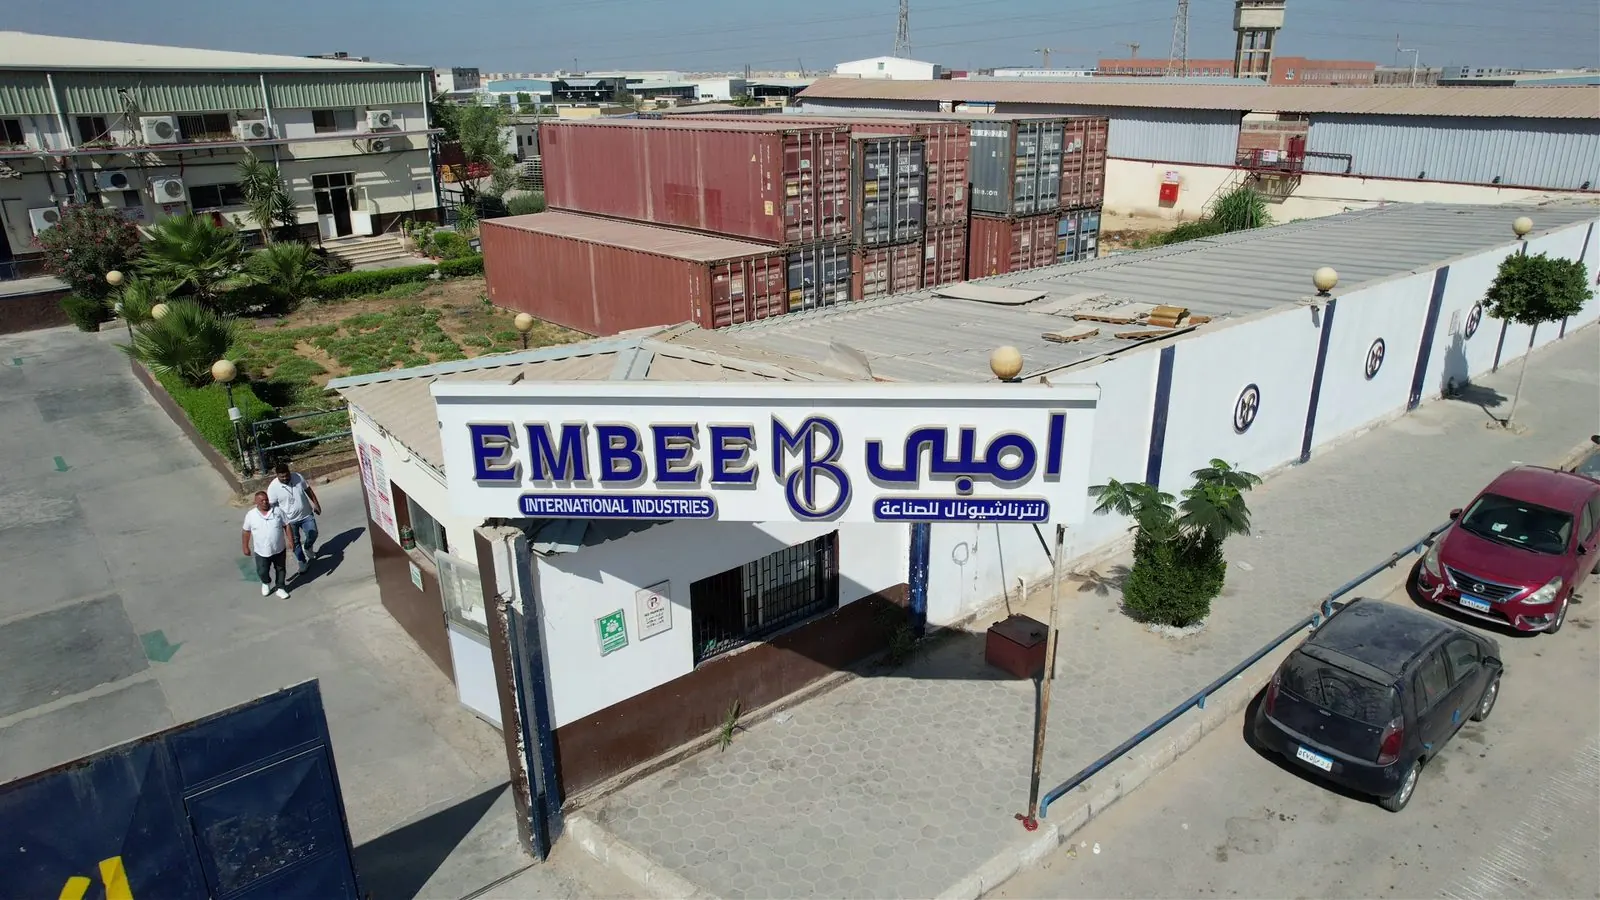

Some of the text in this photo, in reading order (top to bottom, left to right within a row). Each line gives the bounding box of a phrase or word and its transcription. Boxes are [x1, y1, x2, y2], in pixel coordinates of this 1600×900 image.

[470, 422, 757, 485] EMBEE
[524, 497, 710, 514] INTERNATIONAL INDUSTRIES
[880, 501, 1045, 519] انترناشيونال للصناعة
